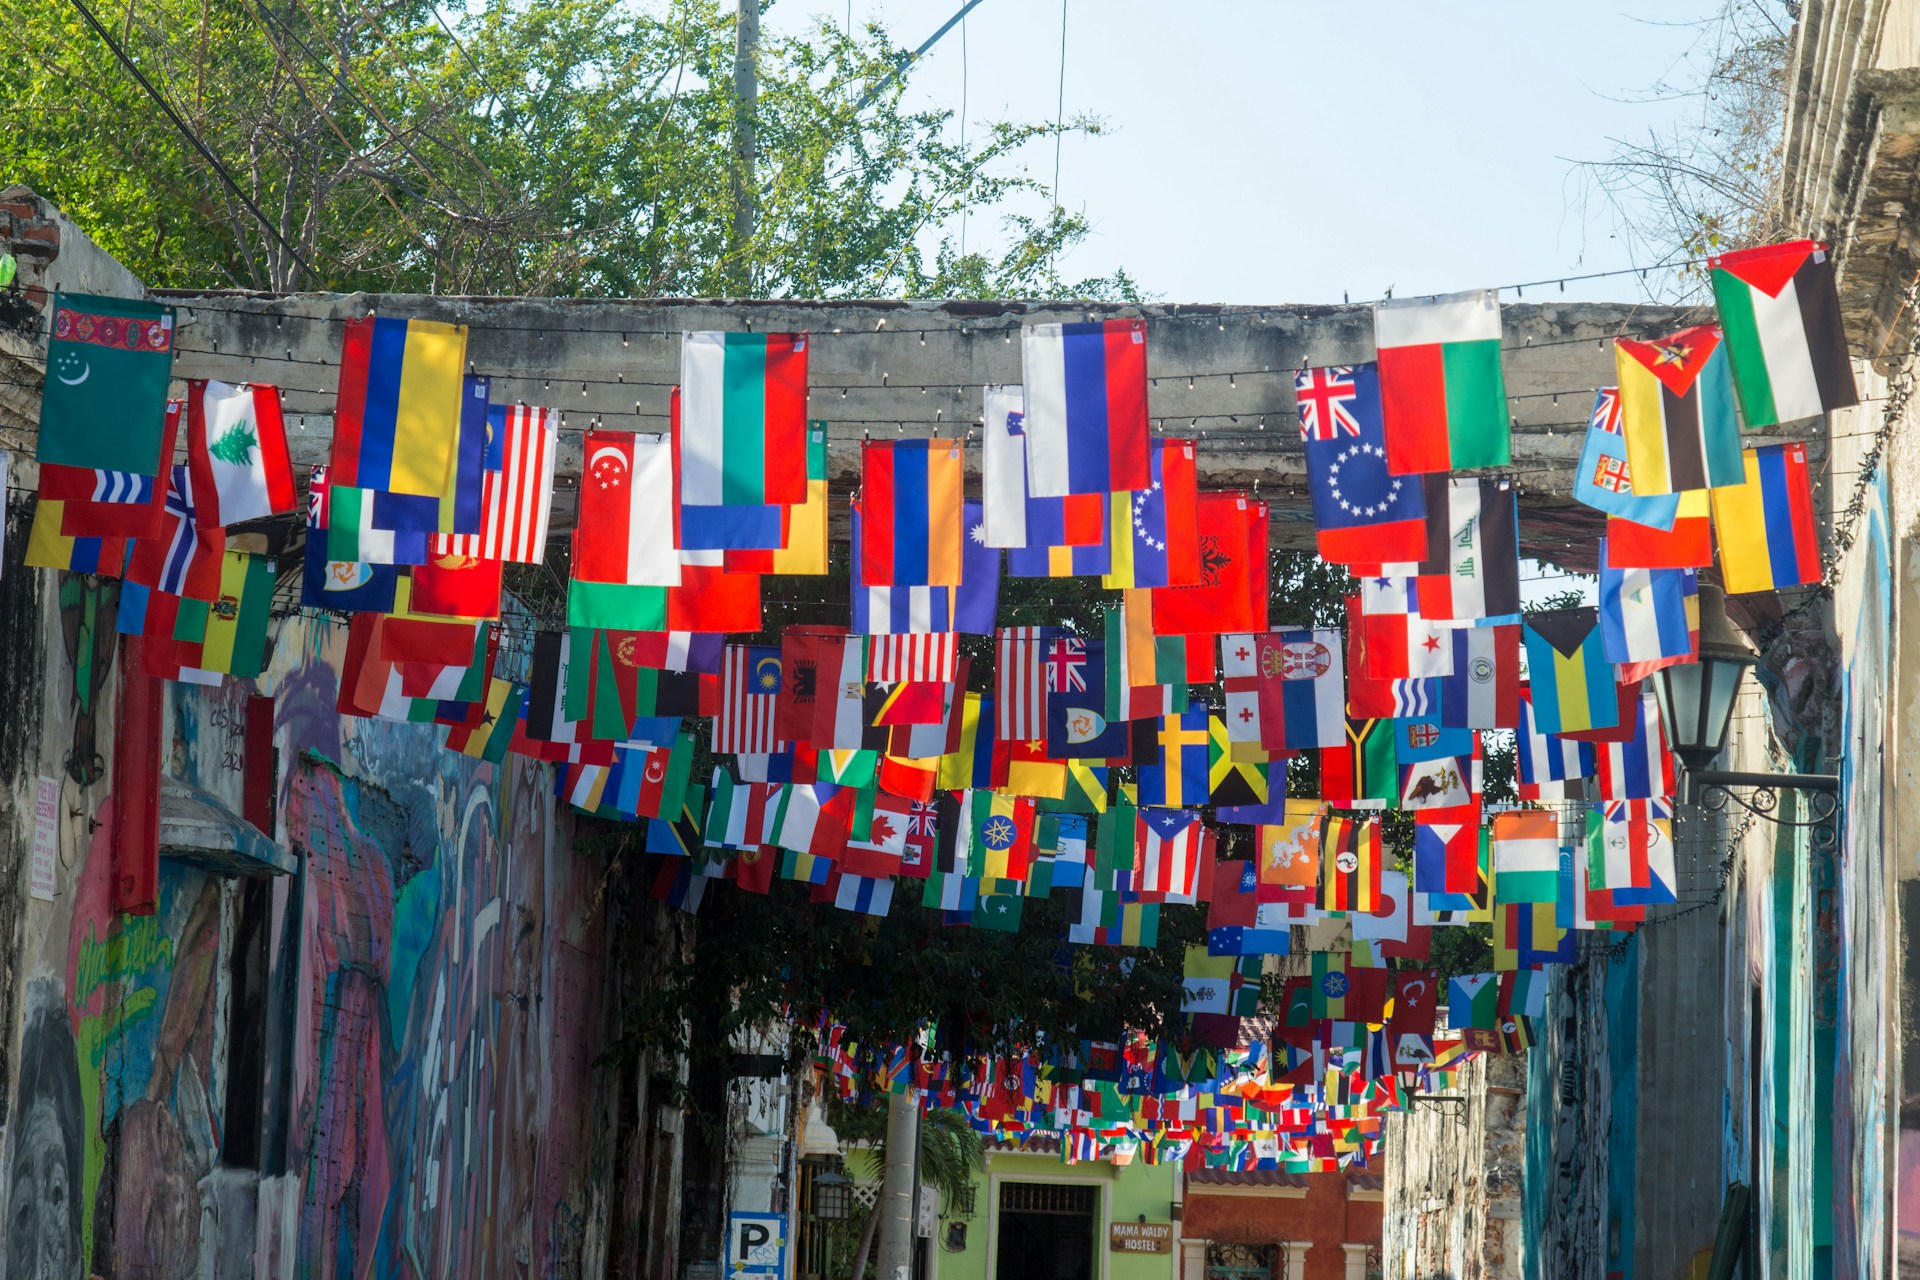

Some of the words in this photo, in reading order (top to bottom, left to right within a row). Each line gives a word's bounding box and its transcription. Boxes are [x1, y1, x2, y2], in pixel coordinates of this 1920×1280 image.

[1113, 1225, 1139, 1236] MAMA
[1141, 1226, 1169, 1238] WALDY
[740, 1224, 769, 1260] P
[1124, 1238, 1156, 1251] HOSTEL
